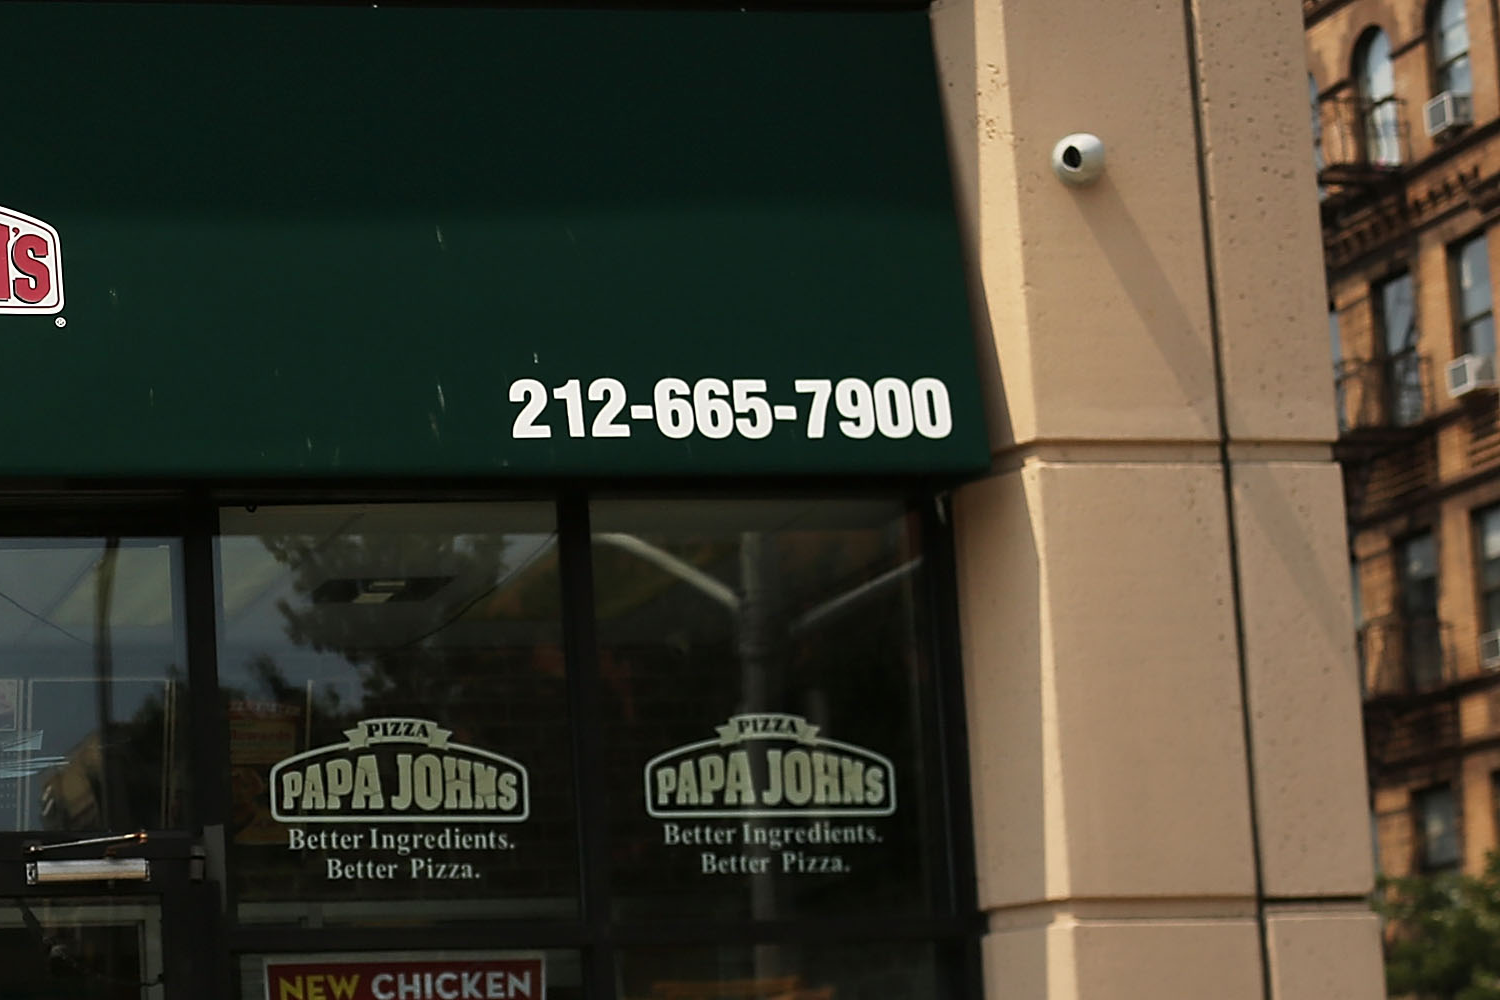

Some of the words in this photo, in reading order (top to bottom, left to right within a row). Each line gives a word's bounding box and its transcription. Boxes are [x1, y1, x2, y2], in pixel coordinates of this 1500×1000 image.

[509, 377, 953, 441] 212-665-7900
[366, 721, 430, 738] PIZZA
[737, 718, 799, 734] PIZZA
[282, 753, 386, 811] PAPA
[655, 750, 757, 807] PAPA
[288, 828, 364, 851] Better
[369, 827, 516, 856] Ingredients.
[663, 822, 737, 845] Better
[742, 820, 885, 850] Ingredients.
[326, 858, 398, 880] Better
[410, 857, 481, 880] Pizza.
[701, 852, 772, 875] Better
[781, 851, 852, 874] Pizza.
[370, 971, 532, 1000] CHICKEN
